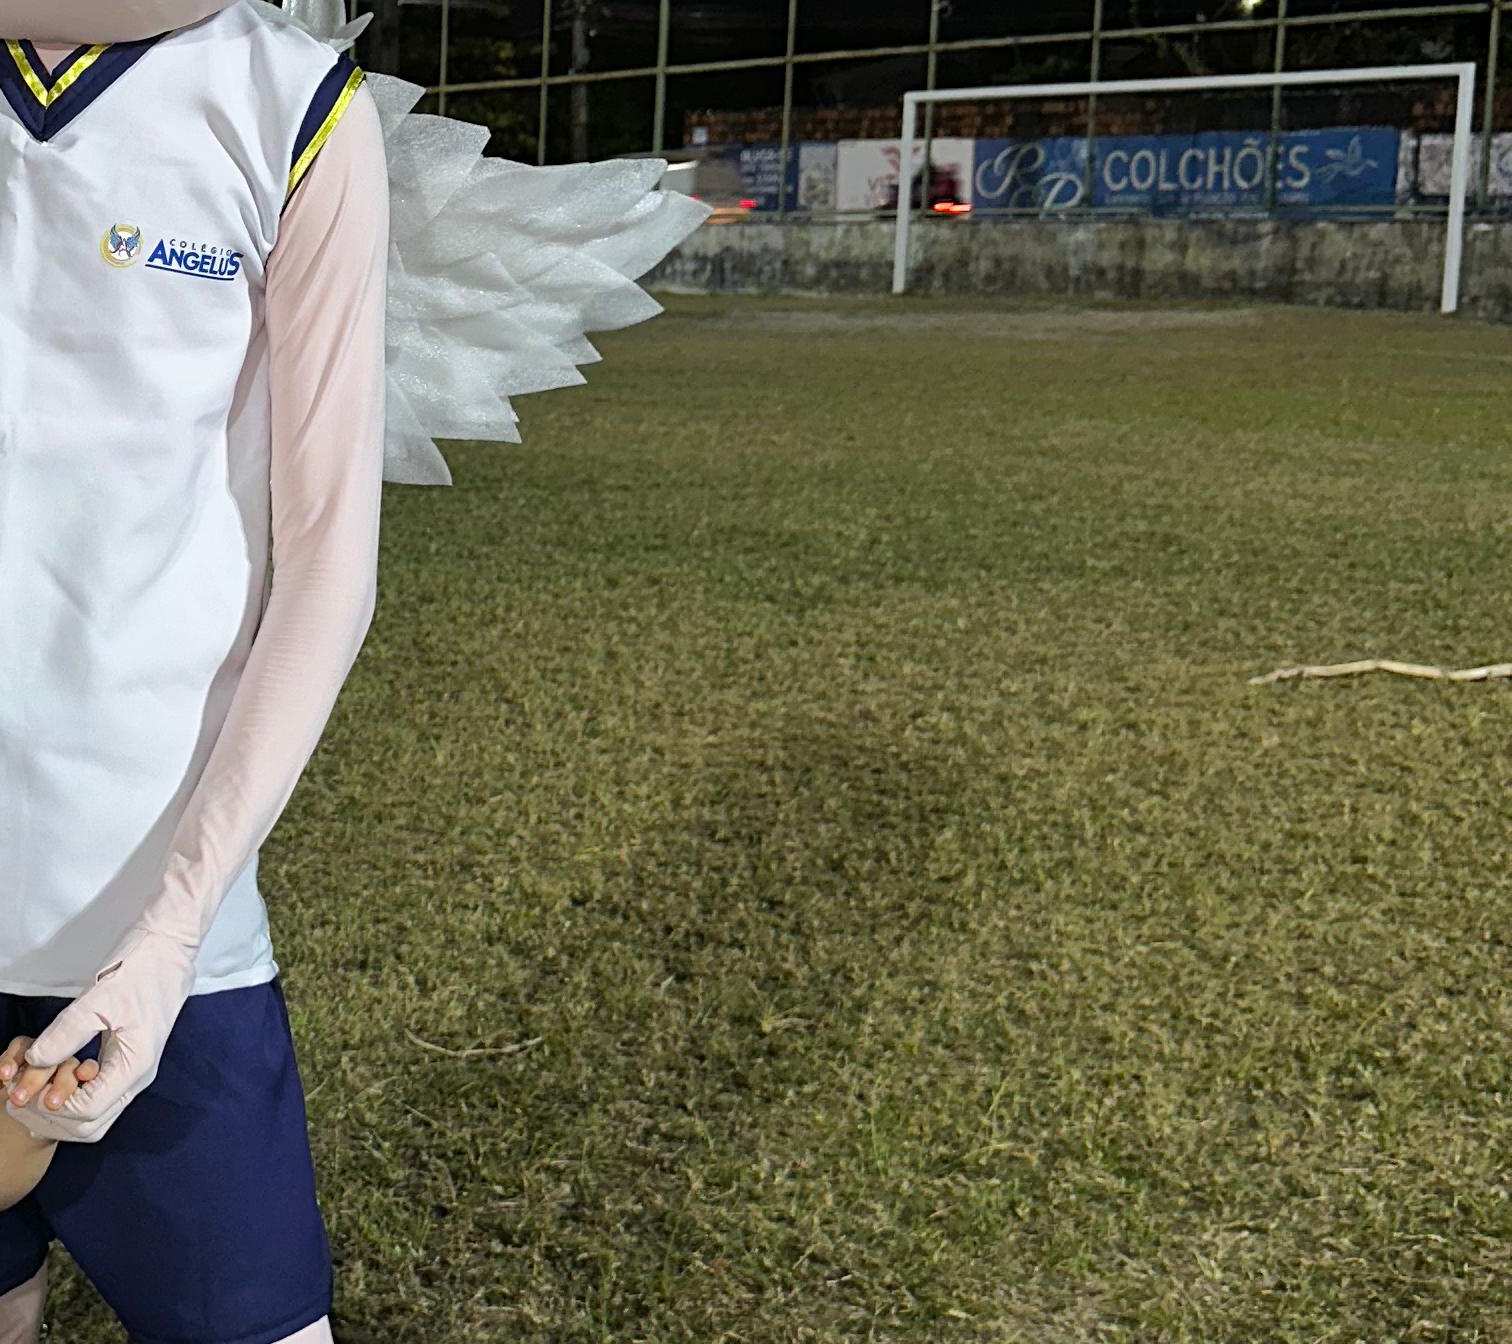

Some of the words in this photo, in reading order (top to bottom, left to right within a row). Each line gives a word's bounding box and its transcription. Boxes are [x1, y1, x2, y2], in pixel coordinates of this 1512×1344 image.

[1102, 137, 1312, 193] COLCHÕES
[147, 238, 245, 276] ANGELUS
[169, 238, 232, 256] COLÉGIO
